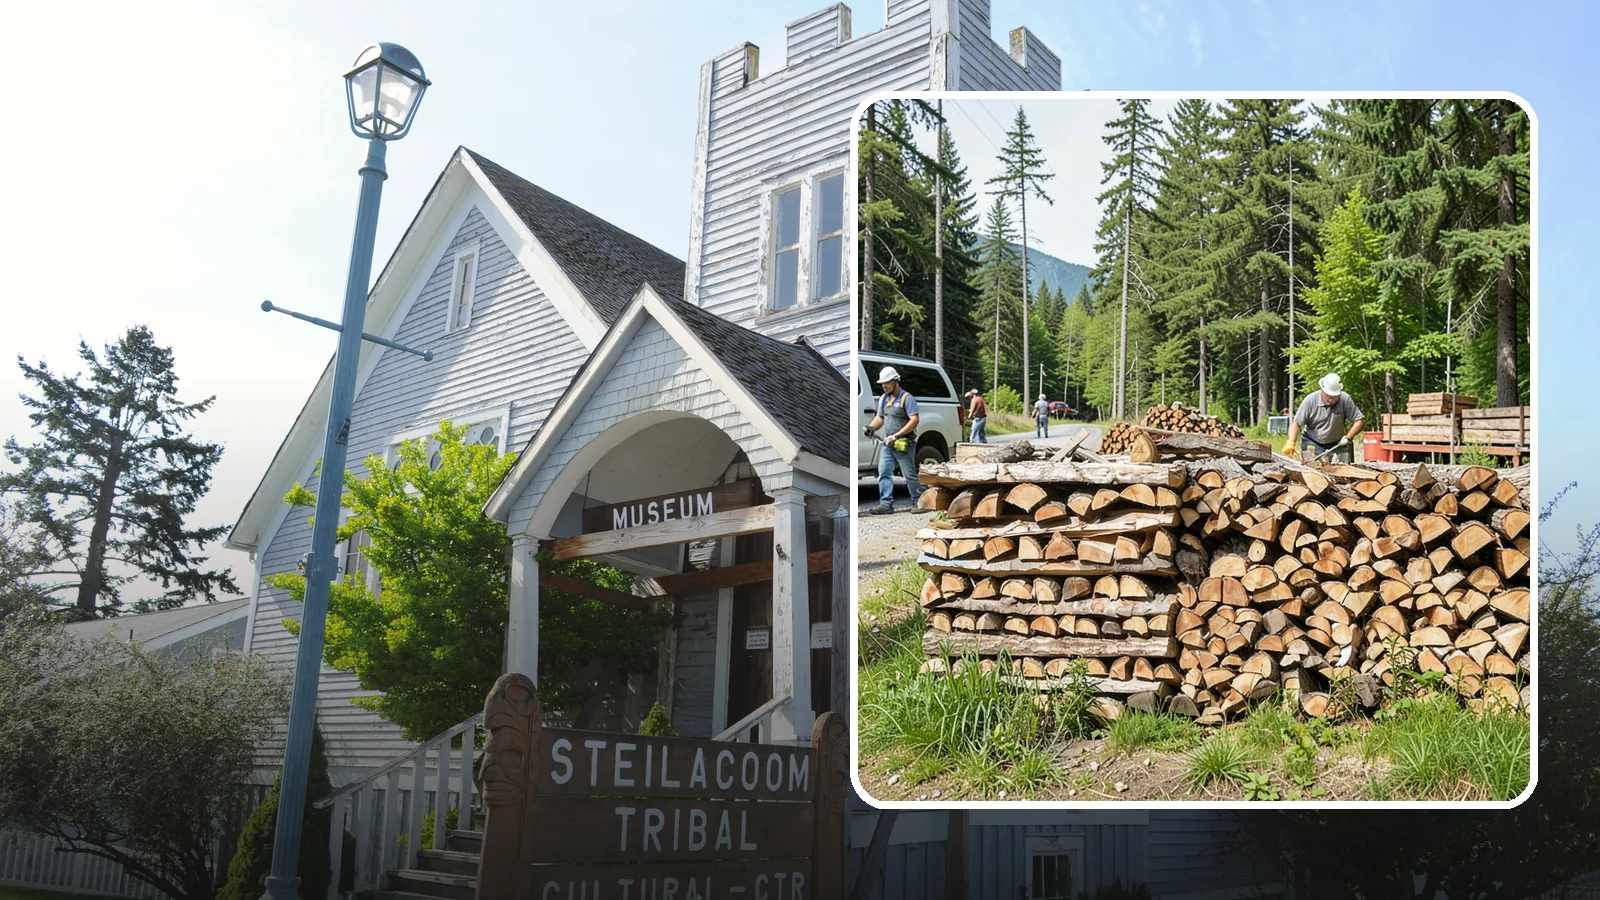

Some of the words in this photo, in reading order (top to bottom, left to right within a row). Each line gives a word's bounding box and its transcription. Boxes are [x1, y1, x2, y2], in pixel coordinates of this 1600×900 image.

[613, 491, 714, 531] MUSEUM
[550, 738, 810, 792] STEILACOOM
[614, 806, 758, 852] TRIBAL
